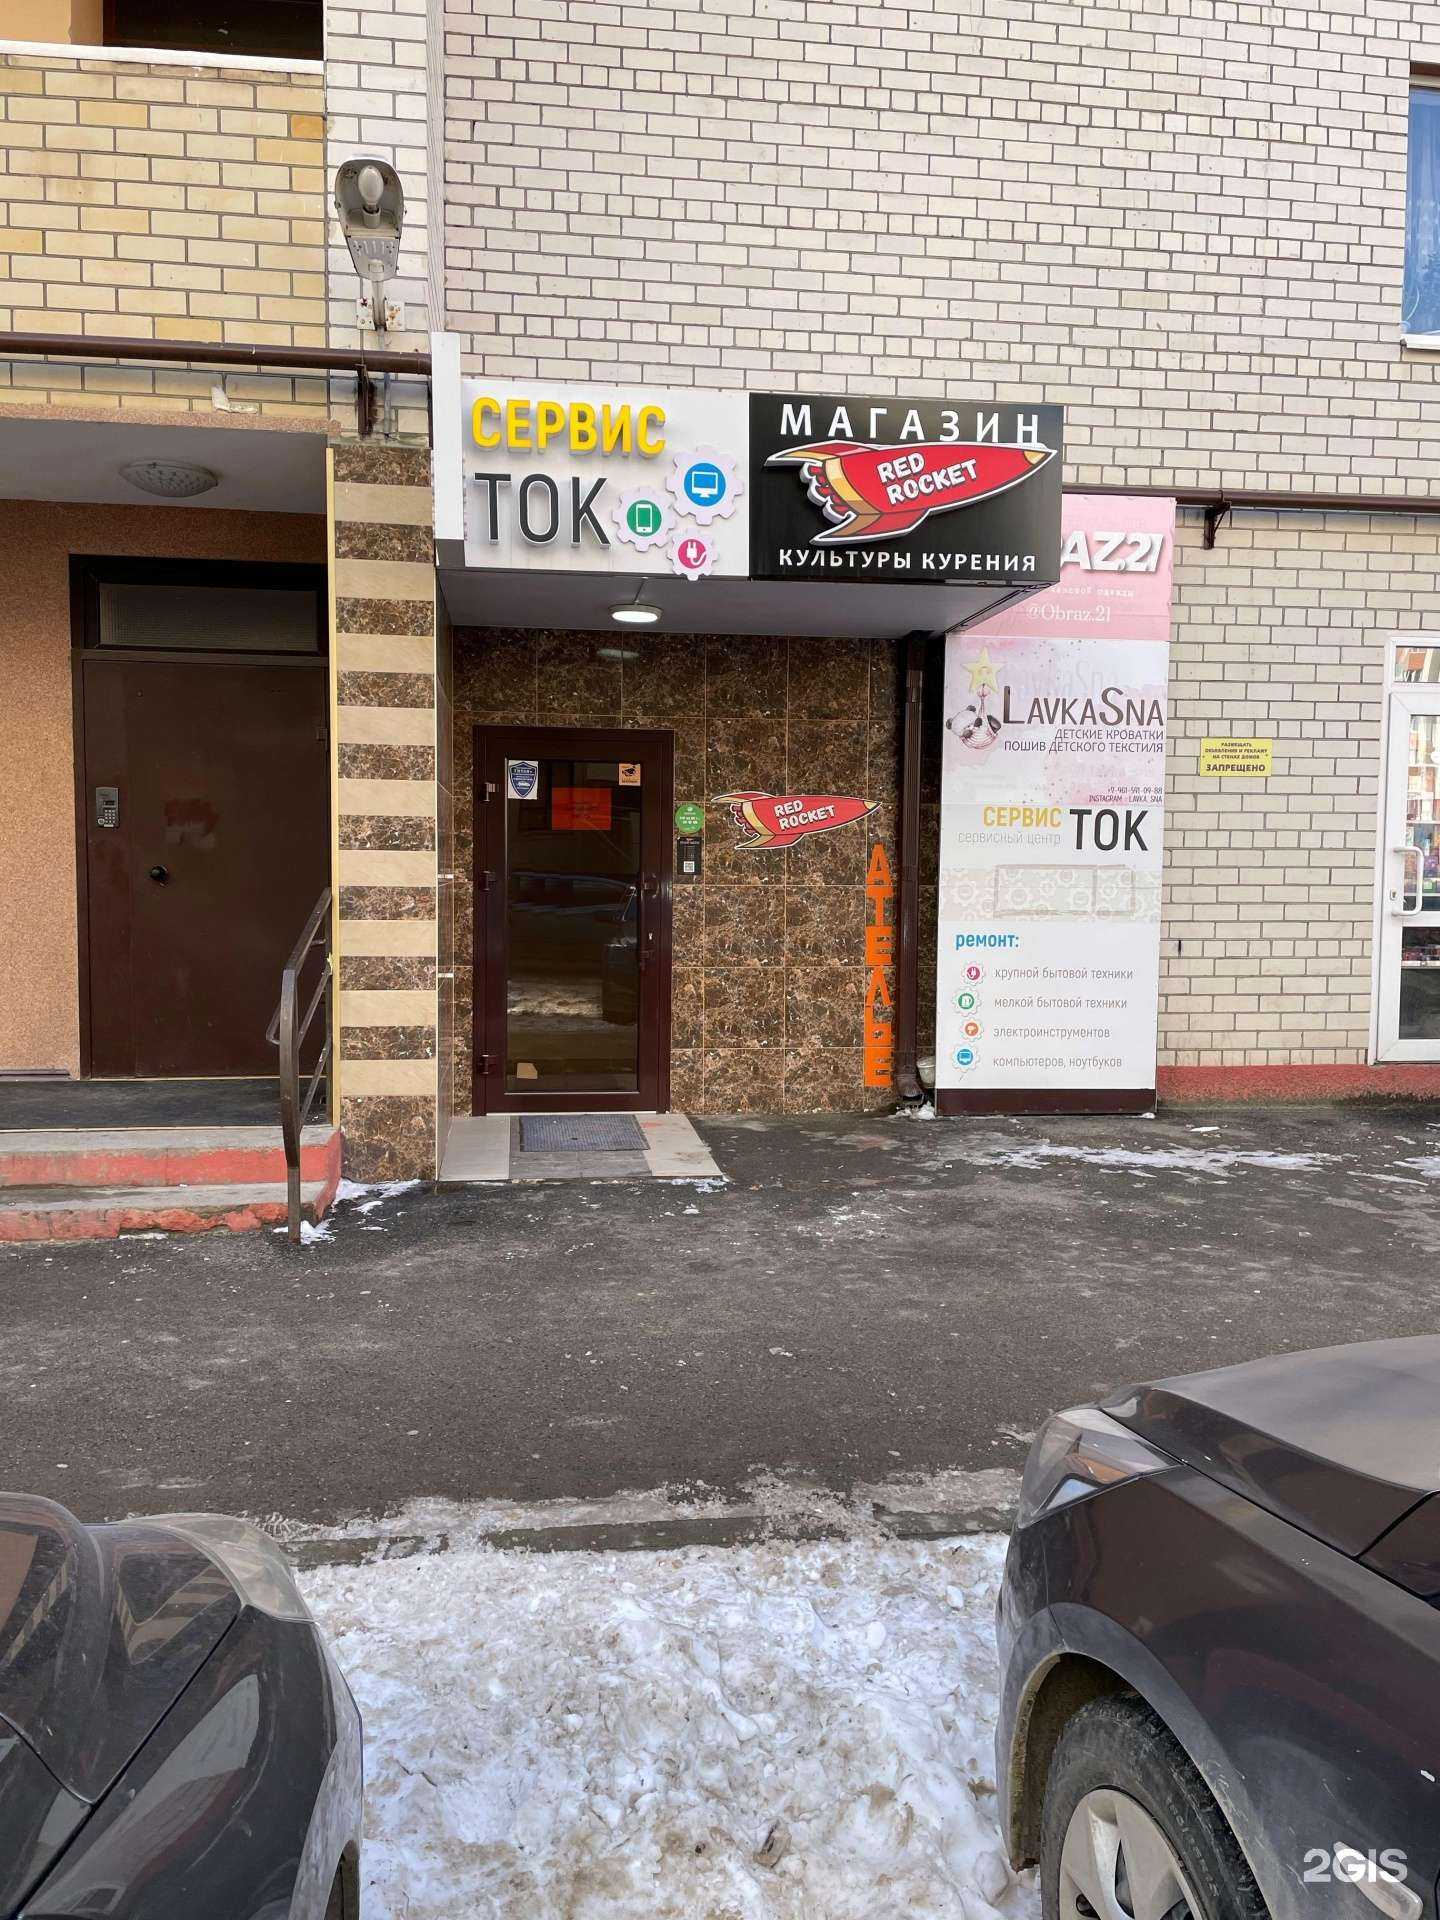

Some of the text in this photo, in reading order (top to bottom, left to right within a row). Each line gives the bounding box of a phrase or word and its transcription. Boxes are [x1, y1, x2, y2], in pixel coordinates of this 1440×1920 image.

[471, 396, 667, 458] СЕРВИС
[781, 403, 1040, 445] МАГАЗИН
[877, 453, 925, 484] RED
[887, 459, 978, 505] ROCKET
[473, 471, 612, 549] ТОК
[778, 549, 1037, 572] КУЛЬТУРЫ КУРЕНИЯ
[1054, 728, 1164, 740] ДЕТСКИЕ КРОВАТКИ
[1004, 741, 1163, 754] ПОШИВ ДЕТСКОГО ТЕКСТИЛЯ
[1206, 764, 1266, 772] ЗАПРЕЩЕНО
[774, 800, 803, 818] RED
[779, 805, 837, 830] ROCKET
[983, 806, 1150, 851] СЕРВИС ТОК
[958, 830, 1061, 846] сервисный центр
[955, 933, 1019, 951] ремонт:
[864, 843, 893, 1088] АТЕЛЬЕ
[994, 967, 1134, 980] крупной бытовой техники
[994, 996, 1128, 1008] мелкой бытовой техники
[993, 1027, 1110, 1039] электроинструментов
[993, 1056, 1122, 1069] компьютеров, ноутбуков
